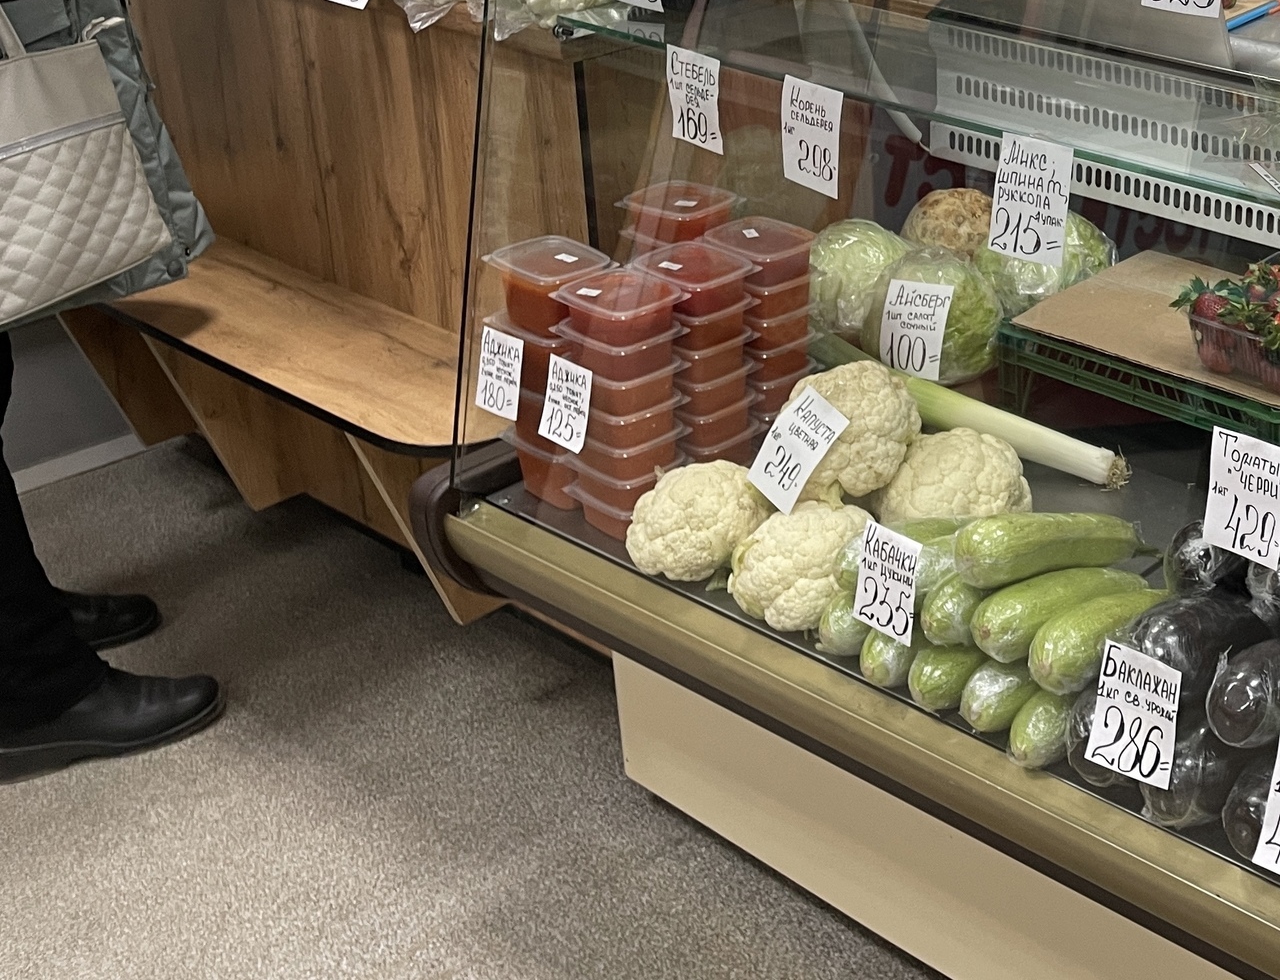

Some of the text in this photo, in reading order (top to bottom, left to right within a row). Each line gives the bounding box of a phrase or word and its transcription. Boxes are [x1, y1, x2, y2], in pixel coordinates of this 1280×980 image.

[671, 51, 716, 86] СТЕБЕЛЬ
[790, 85, 826, 118] КОРЕНЬ
[790, 110, 834, 133] СЕЛЬДЕРЕЯ
[997, 185, 1051, 210] РУККОЛА
[889, 284, 950, 316] АЙСБЕРГ
[484, 330, 520, 363] АДЖИКА
[552, 361, 587, 390] АДЖИКА
[789, 421, 819, 451] ЦВЕТНАЯ
[794, 395, 836, 445] КАПУСТА
[1218, 431, 1280, 477] ТОМАТЫ
[865, 523, 917, 577] КАБАЧКИ
[1103, 644, 1177, 705] БАКЛАЖАН
